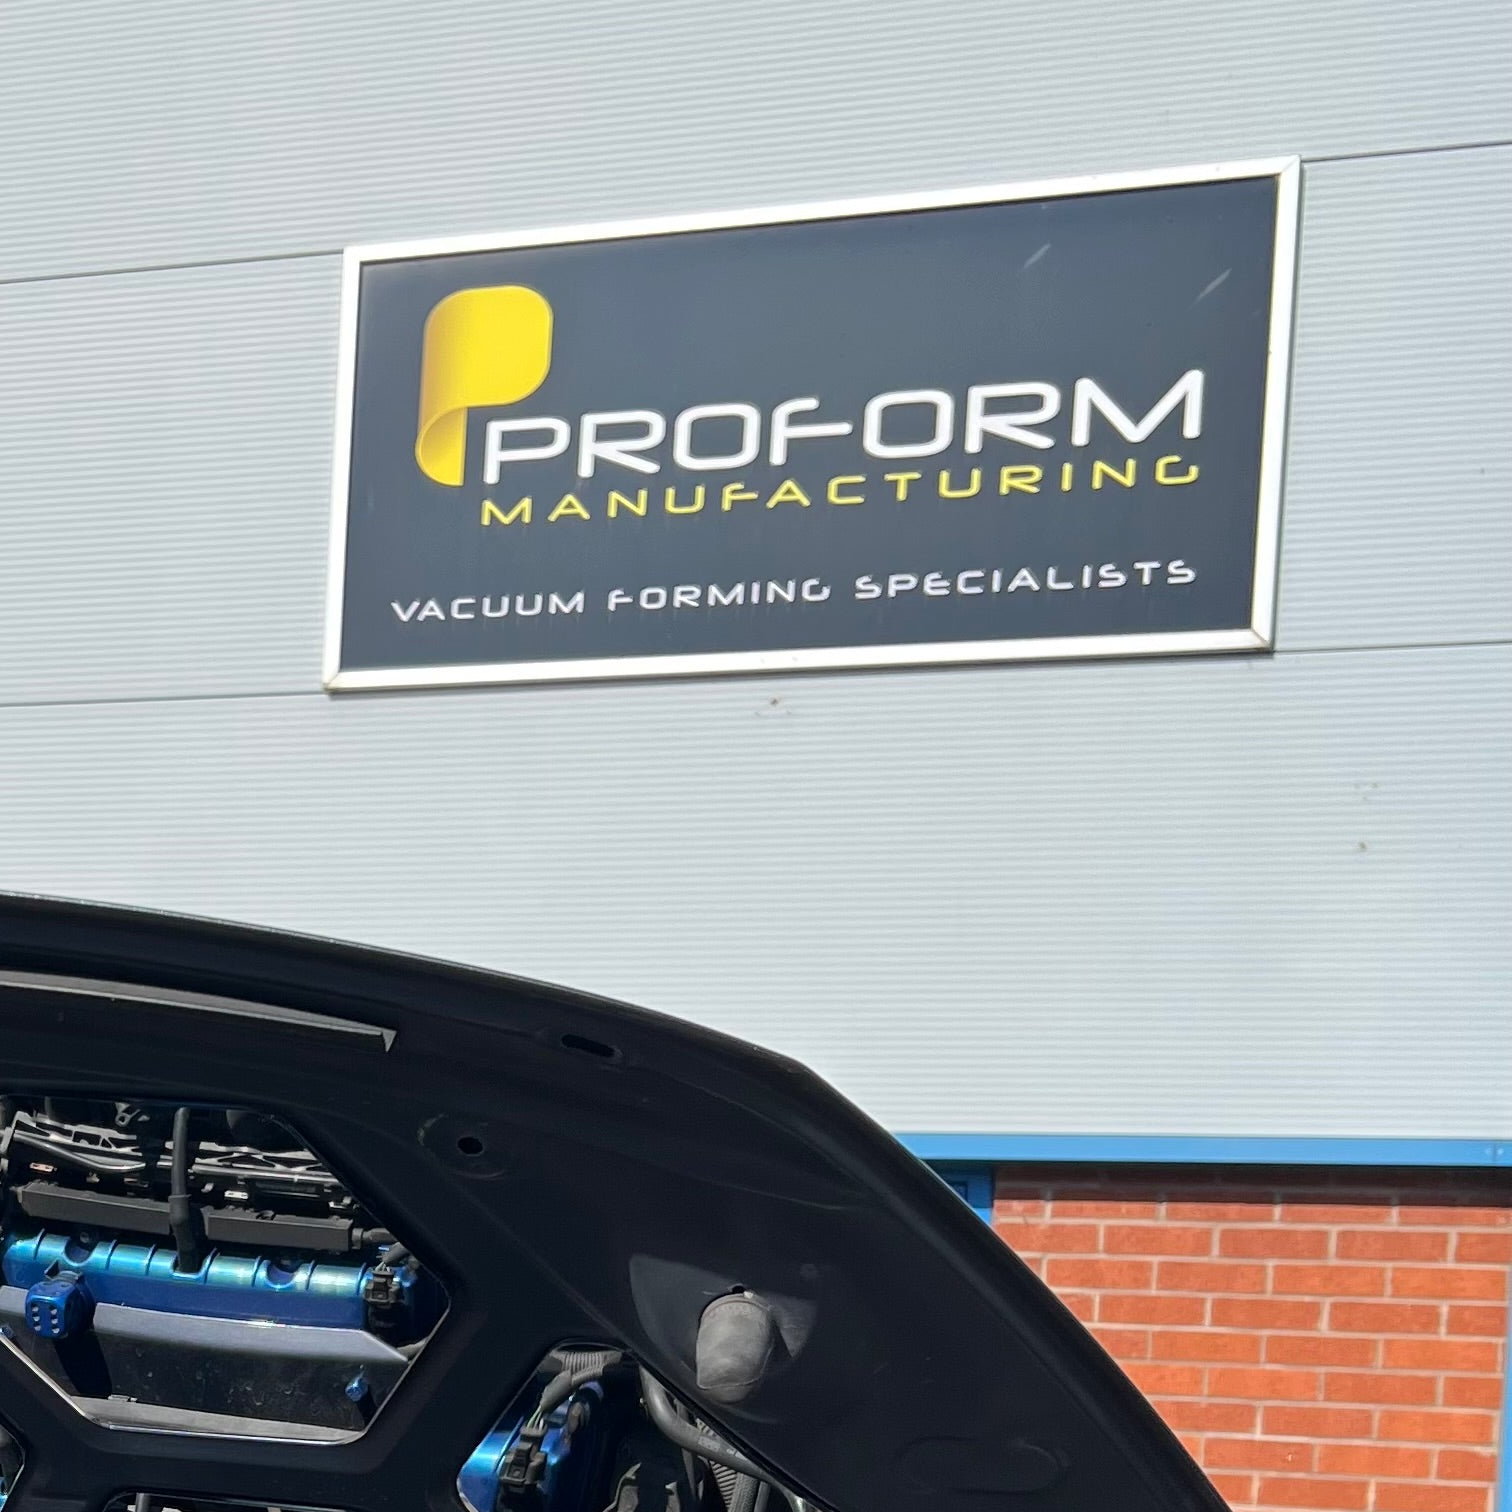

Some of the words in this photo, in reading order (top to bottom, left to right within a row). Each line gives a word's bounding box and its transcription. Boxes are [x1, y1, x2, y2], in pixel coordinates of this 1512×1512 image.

[483, 369, 1205, 484] PROFORM
[482, 457, 1197, 525] MANUFACTURING
[390, 591, 585, 622] VACUUM
[607, 578, 831, 612] FORMING
[854, 559, 1196, 600] SPECIALISTS
